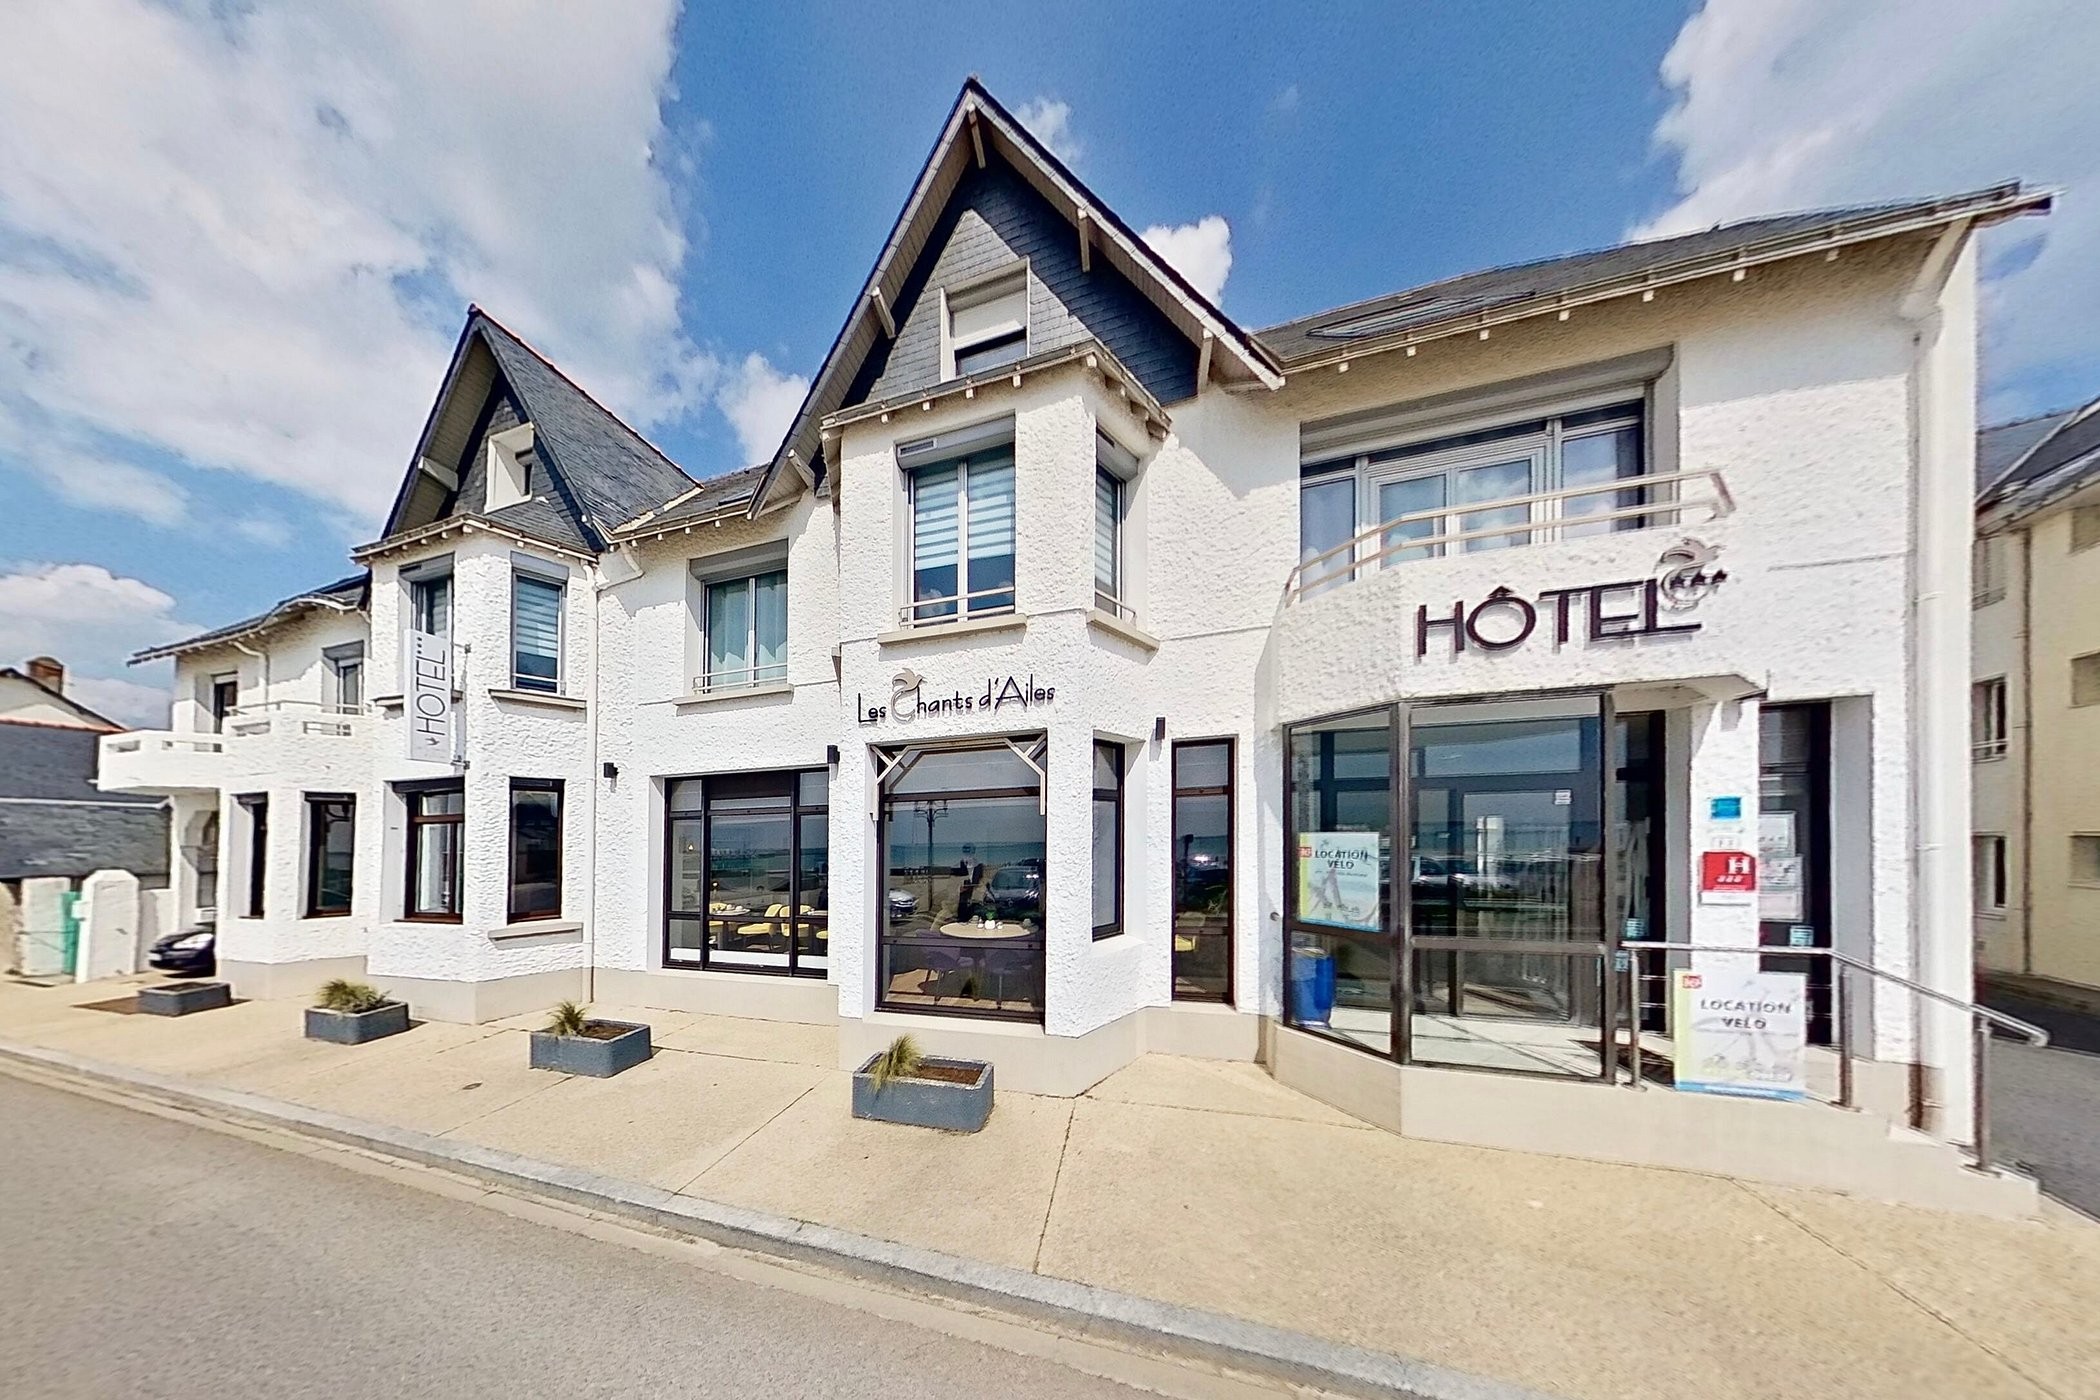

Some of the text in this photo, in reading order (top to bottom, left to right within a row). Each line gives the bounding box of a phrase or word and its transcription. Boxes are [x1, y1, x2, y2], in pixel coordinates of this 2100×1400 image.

[1417, 578, 1702, 657] HÔTEL
[416, 650, 446, 735] HOTEL
[858, 673, 1056, 723] Les Chants d'Ailes
[1315, 849, 1368, 861] LOCATION
[1728, 856, 1750, 875] H
[1700, 999, 1791, 1014] LOCATION
